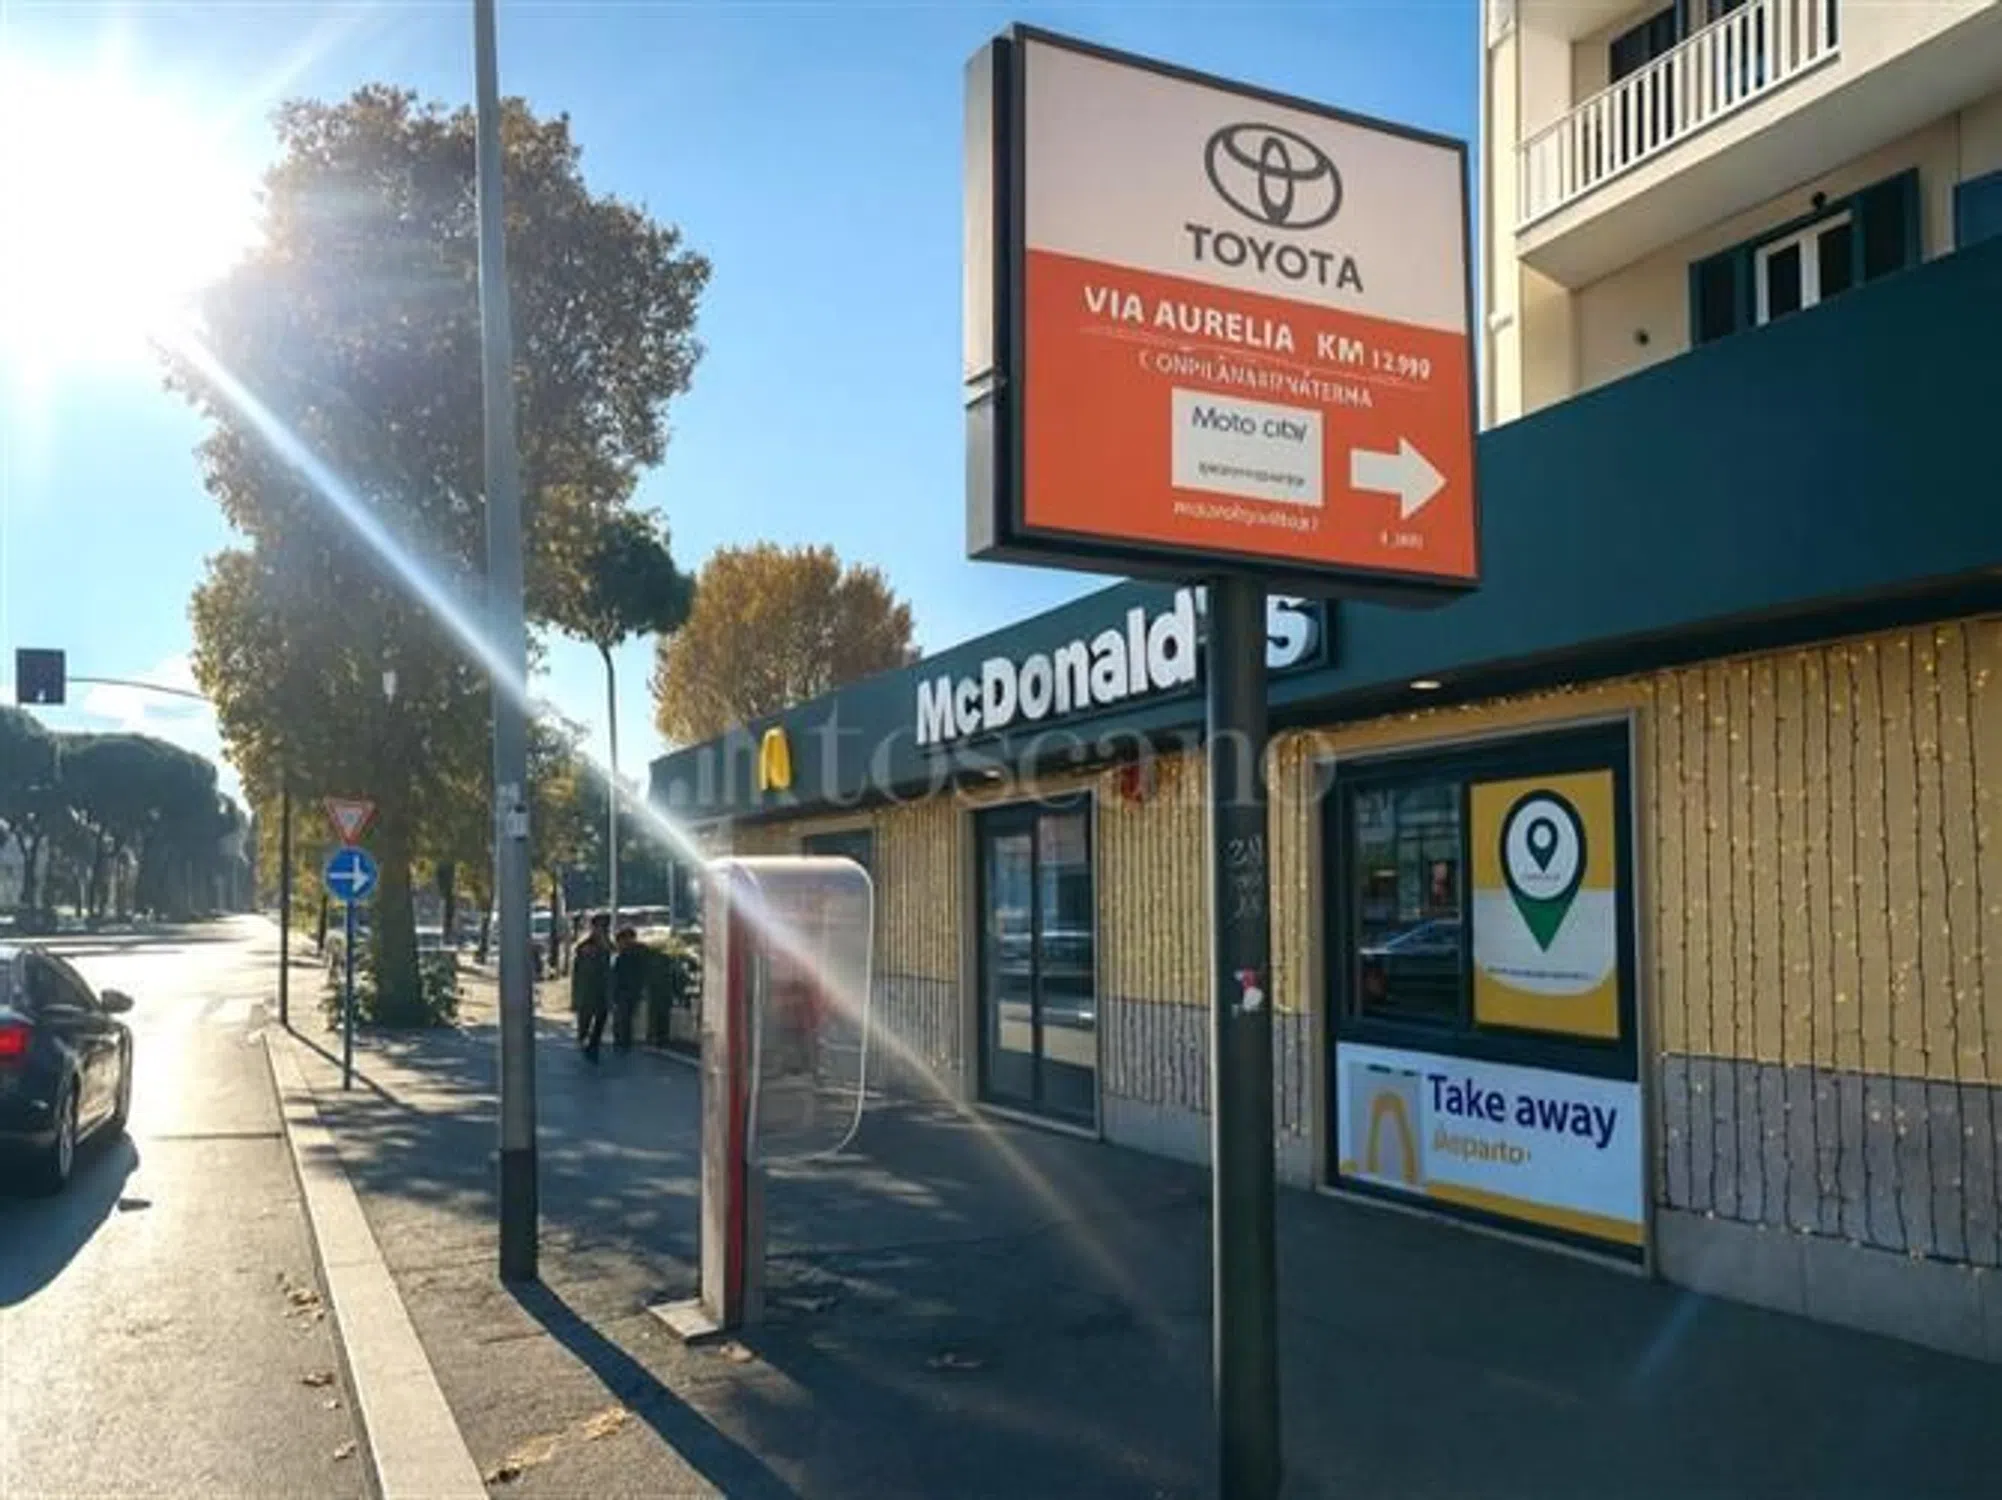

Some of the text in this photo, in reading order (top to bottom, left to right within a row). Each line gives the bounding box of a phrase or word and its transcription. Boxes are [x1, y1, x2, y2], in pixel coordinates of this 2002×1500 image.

[1184, 222, 1364, 294] TOYOTA
[1083, 285, 1145, 324] VIA
[1153, 298, 1296, 352] AURELIA
[1316, 331, 1364, 366] KM
[1192, 405, 1257, 436] Moto
[1427, 1073, 1618, 1149] Take away
